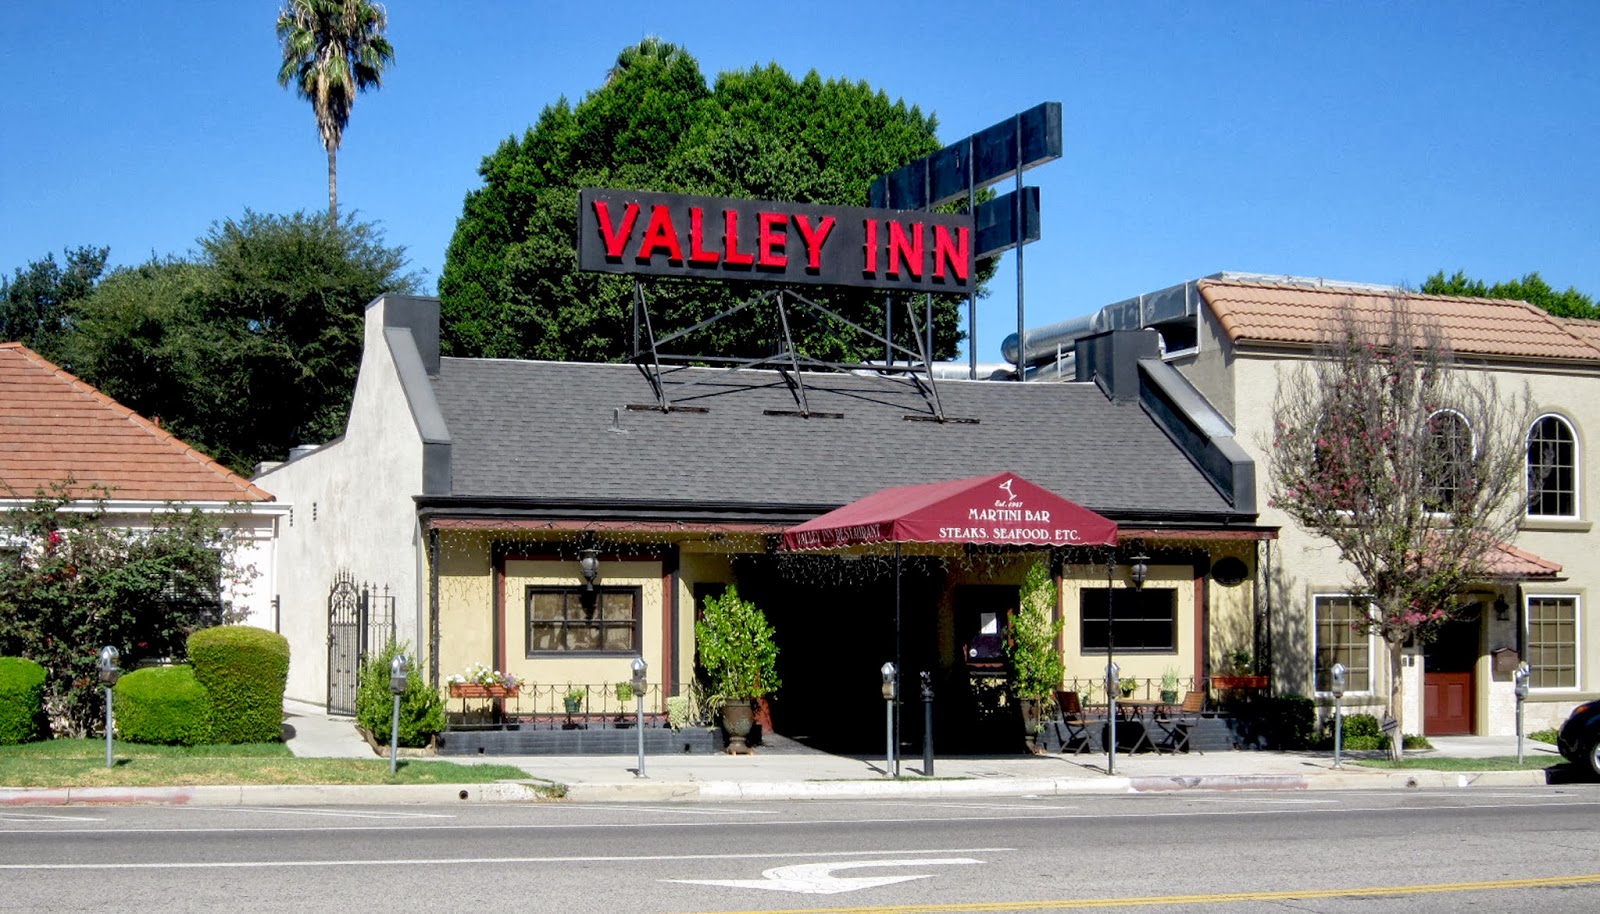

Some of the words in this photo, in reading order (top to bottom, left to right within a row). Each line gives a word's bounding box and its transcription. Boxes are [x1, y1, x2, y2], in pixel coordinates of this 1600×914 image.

[591, 200, 836, 270] VALLEY
[862, 218, 970, 281] INN
[968, 508, 1021, 521] MARTINI
[1025, 510, 1050, 523] BAR
[796, 530, 820, 545] VALLEY
[1055, 529, 1081, 540] ETC.
